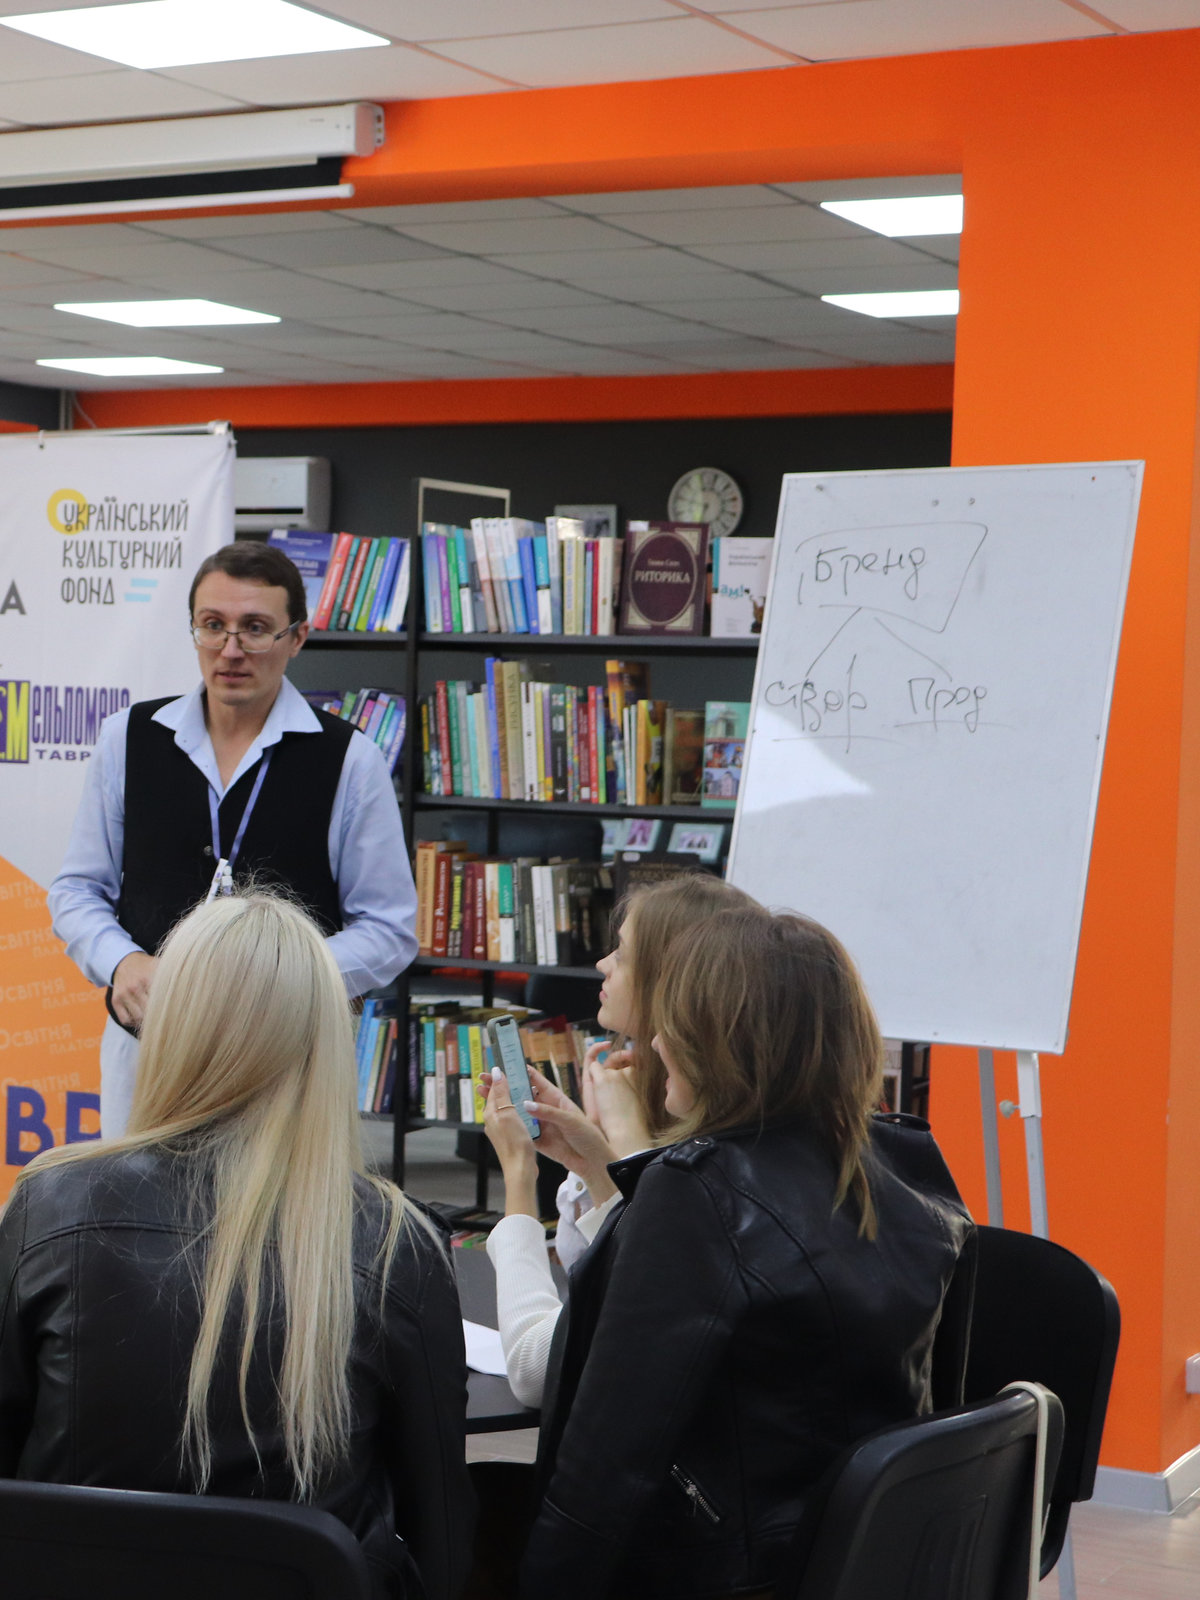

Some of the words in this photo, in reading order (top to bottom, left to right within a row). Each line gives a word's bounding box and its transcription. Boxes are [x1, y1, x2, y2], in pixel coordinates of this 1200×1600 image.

[63, 495, 189, 532] УКРАЇНСЬКИЙ
[62, 536, 183, 570] КУЛЬТУРНИЙ
[60, 576, 115, 605] ФОНД
[634, 569, 691, 584] РИТОРИКА
[814, 546, 926, 601] Бренд
[907, 677, 988, 733] Прод
